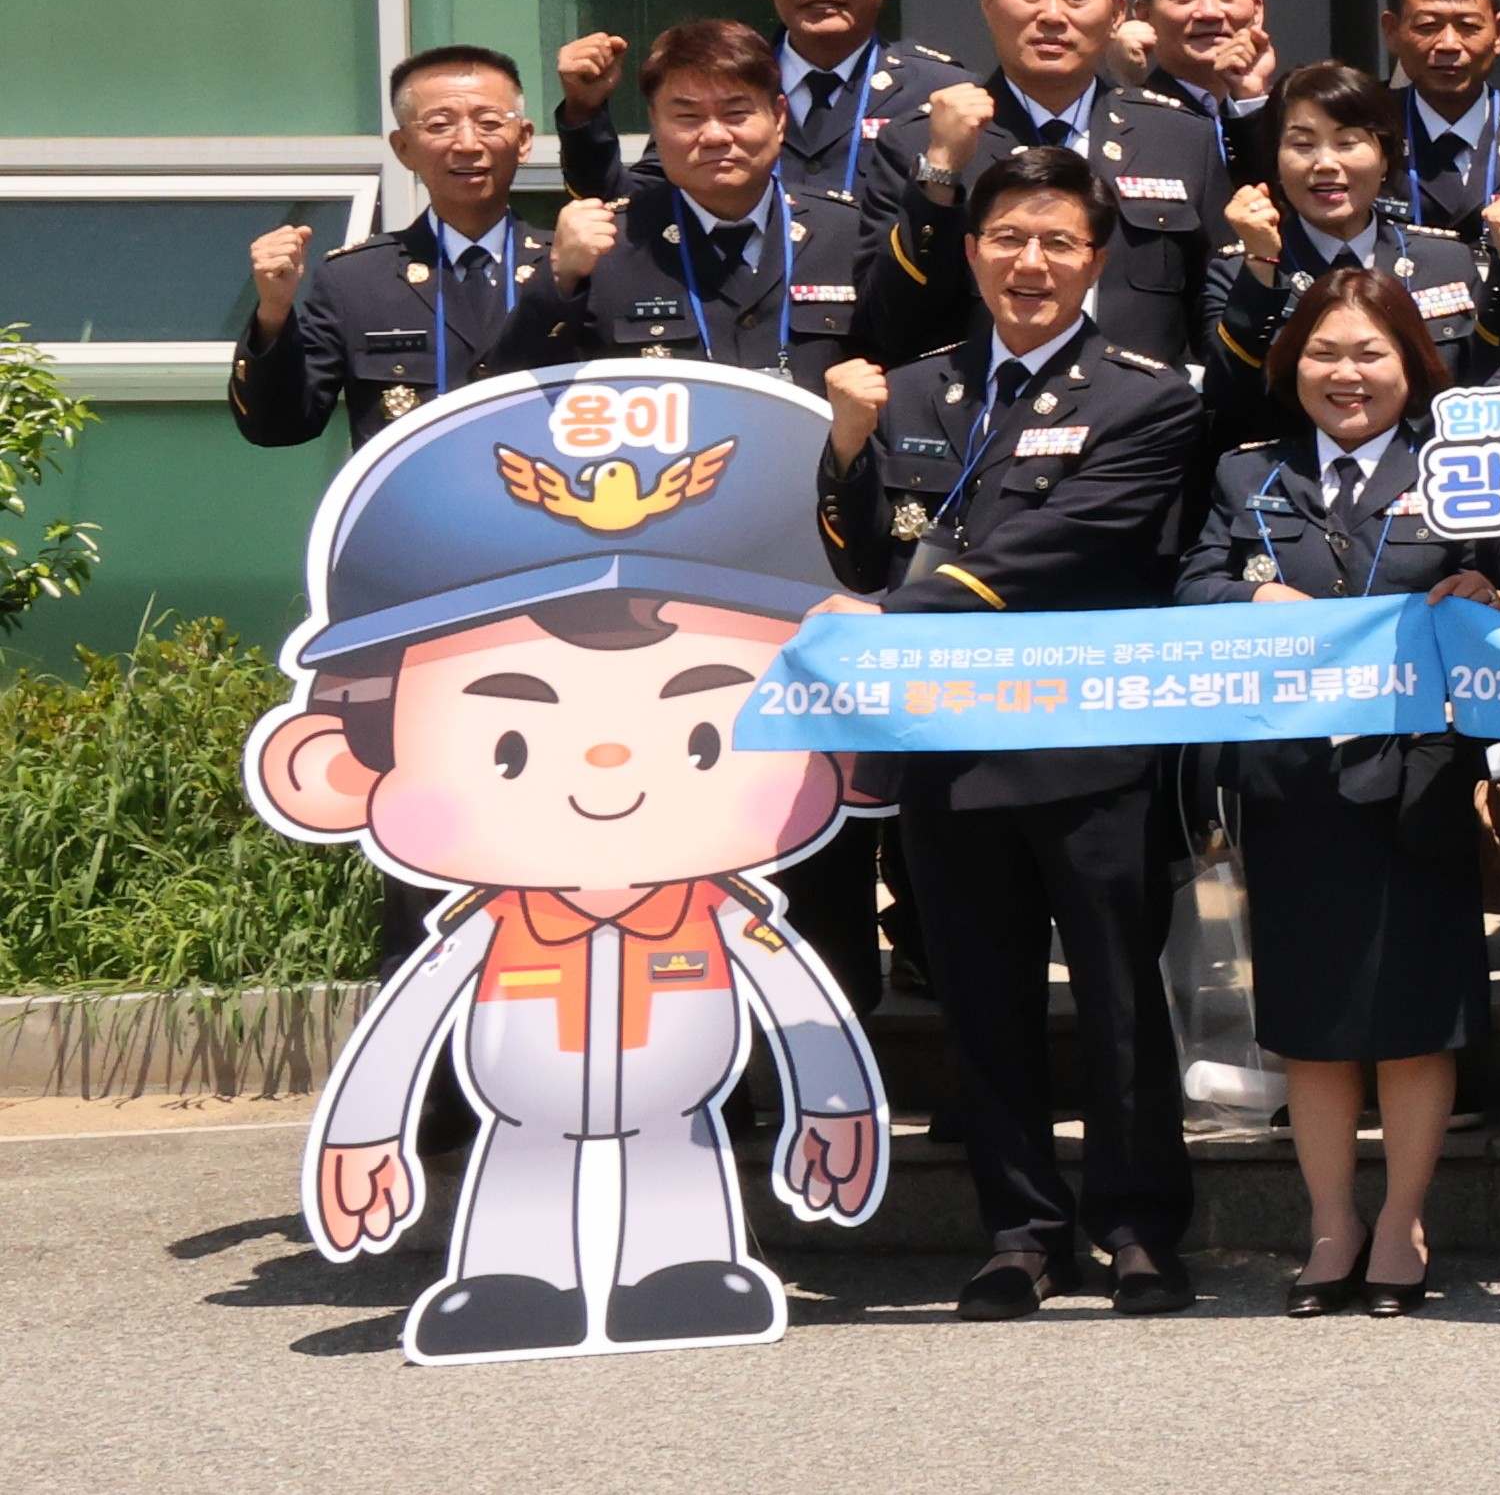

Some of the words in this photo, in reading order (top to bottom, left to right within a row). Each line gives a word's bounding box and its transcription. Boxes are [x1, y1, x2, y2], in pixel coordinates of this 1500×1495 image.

[560, 393, 678, 447] 용이
[858, 649, 922, 668] 소통과
[930, 648, 1013, 667] 화합으로
[1023, 646, 1104, 665] 이어가는
[1212, 637, 1313, 658] 안전지킴이
[760, 681, 890, 714] 2026년
[905, 680, 1068, 714] 광주-대구
[1080, 672, 1259, 709] 의용소방대
[1273, 663, 1418, 703] 교류행사
